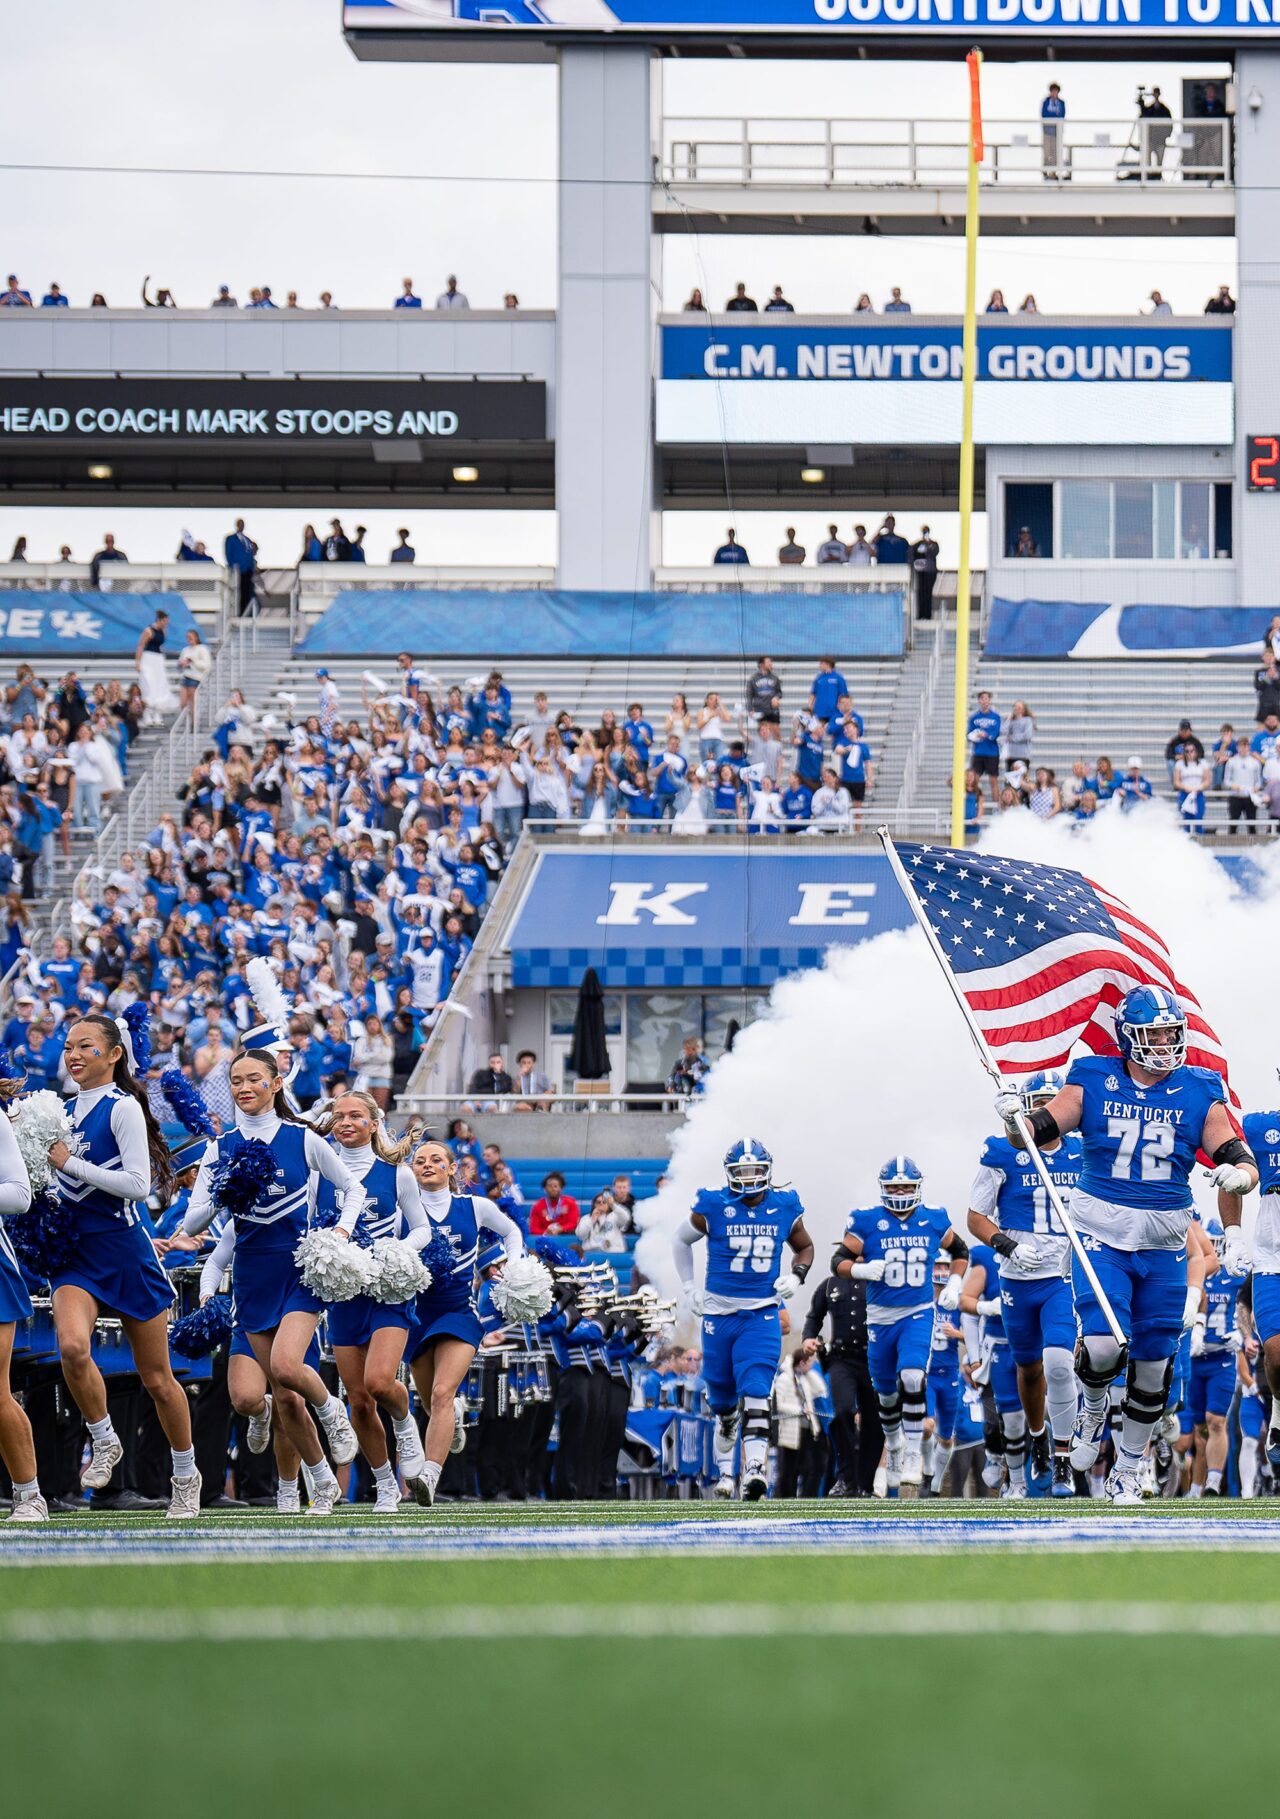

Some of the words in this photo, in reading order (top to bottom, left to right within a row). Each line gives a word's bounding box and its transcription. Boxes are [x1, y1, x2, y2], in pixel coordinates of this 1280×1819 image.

[704, 344, 787, 377] C.M.
[988, 346, 1191, 380] GROUNDS
[75, 407, 180, 433] COACH
[186, 408, 270, 434] MARK
[275, 409, 394, 435] STOOPS
[397, 410, 459, 435] AND
[0, 608, 44, 639] E
[596, 881, 708, 926] K
[788, 881, 877, 926] E
[1102, 1100, 1184, 1125] KENTUCKY
[1107, 1117, 1176, 1181] 72
[726, 1224, 778, 1237] KENTUCKY
[880, 1236, 930, 1249] KENTUCKY
[728, 1236, 776, 1273] 79
[884, 1247, 928, 1288] 66
